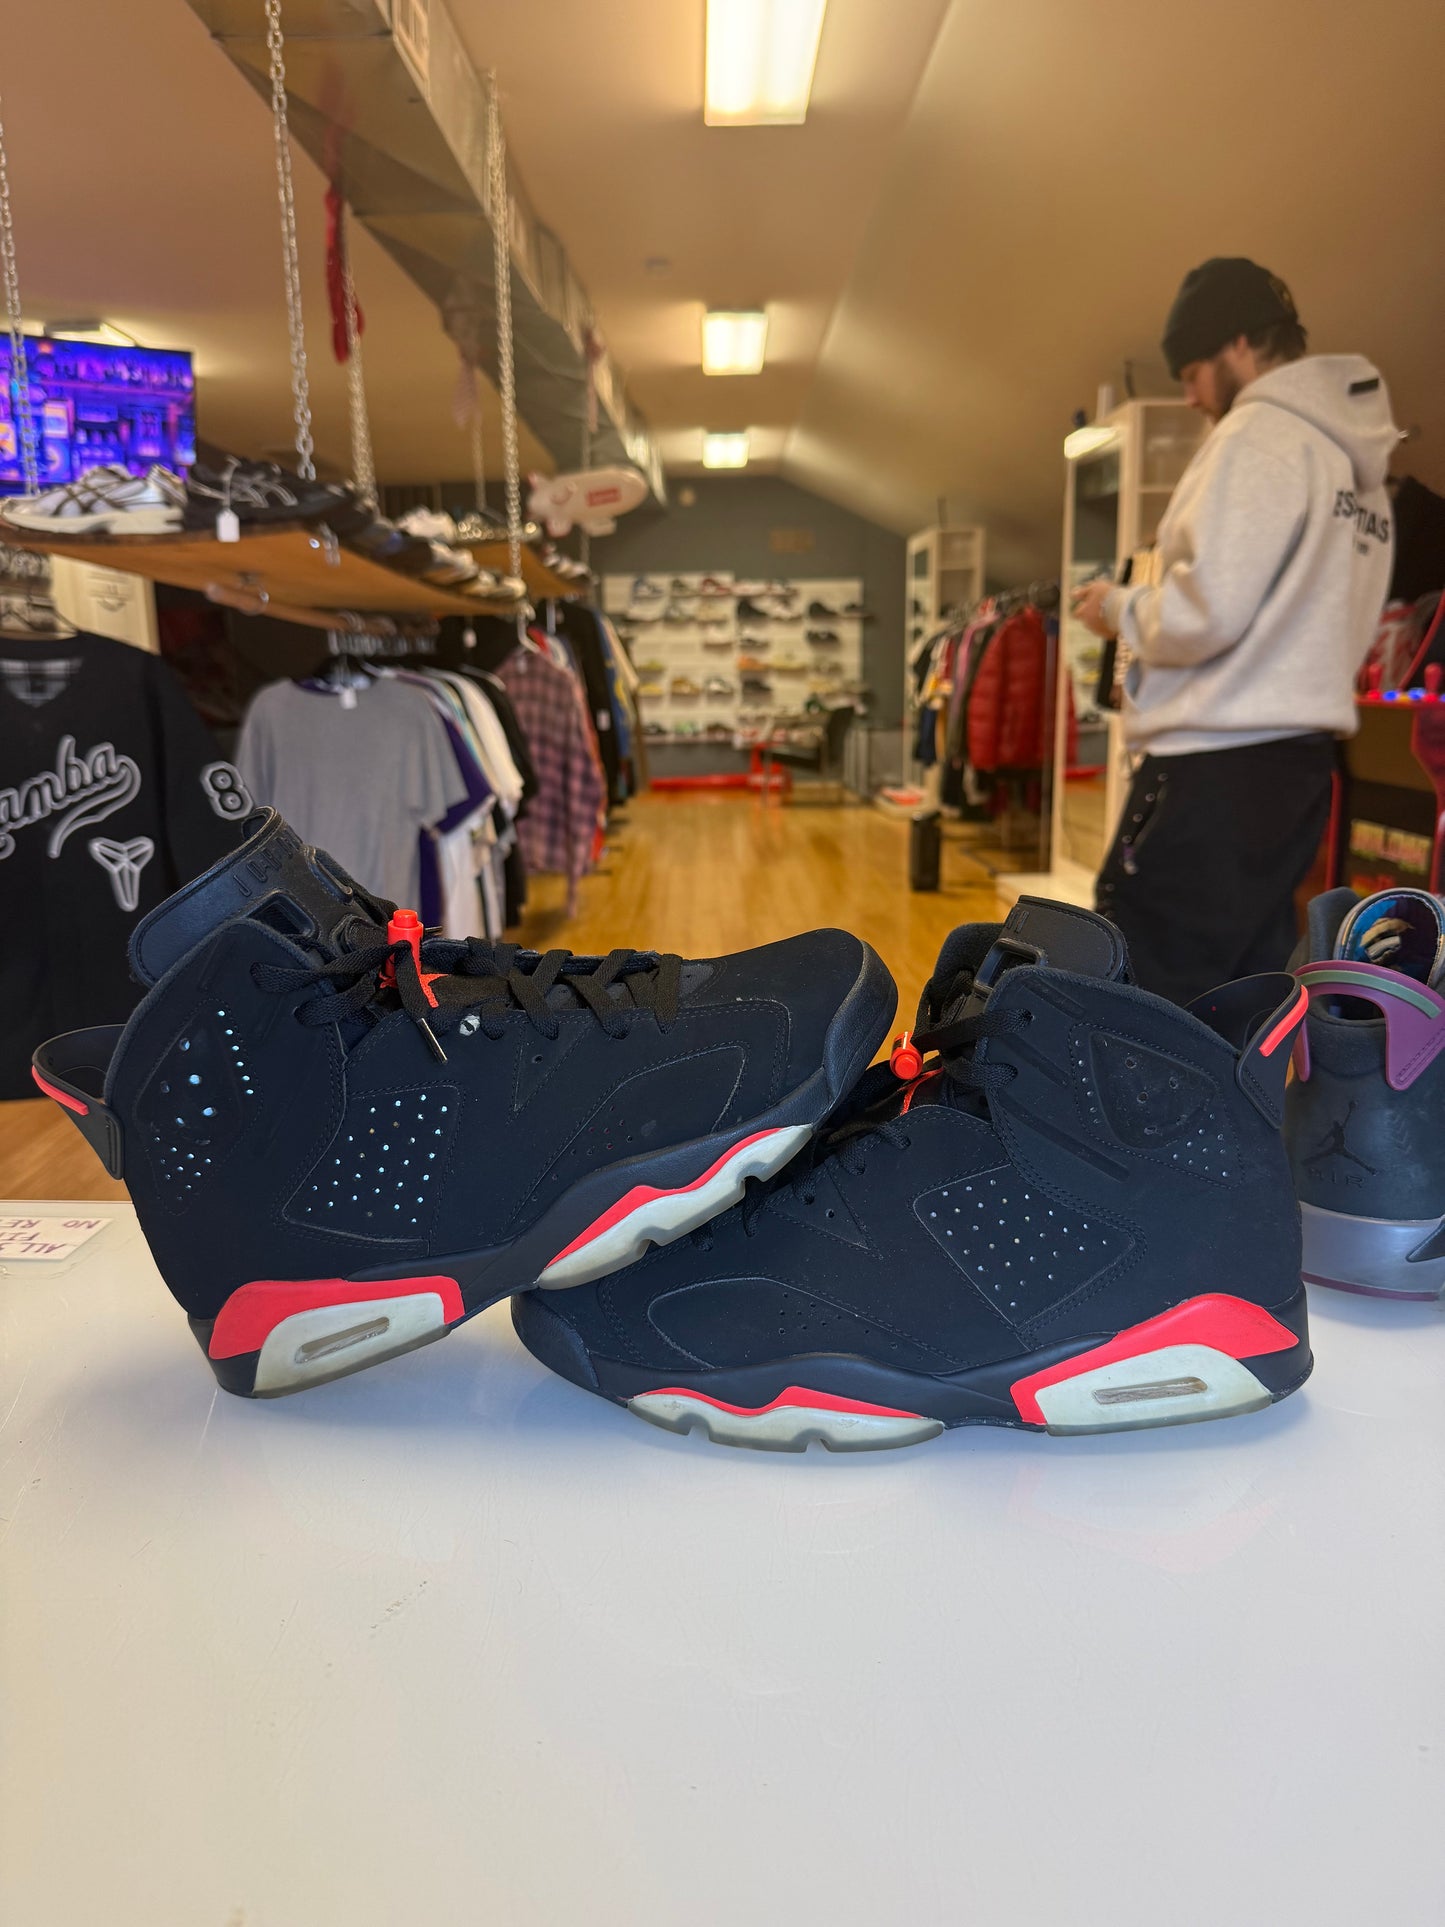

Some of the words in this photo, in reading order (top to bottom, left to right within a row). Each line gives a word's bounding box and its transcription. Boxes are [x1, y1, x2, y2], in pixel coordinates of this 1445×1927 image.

[0, 734, 141, 856] amba
[199, 760, 256, 821] 8
[1308, 1167, 1363, 1189] AIR
[62, 1219, 102, 1229] NO
[20, 1242, 67, 1254] ALL
